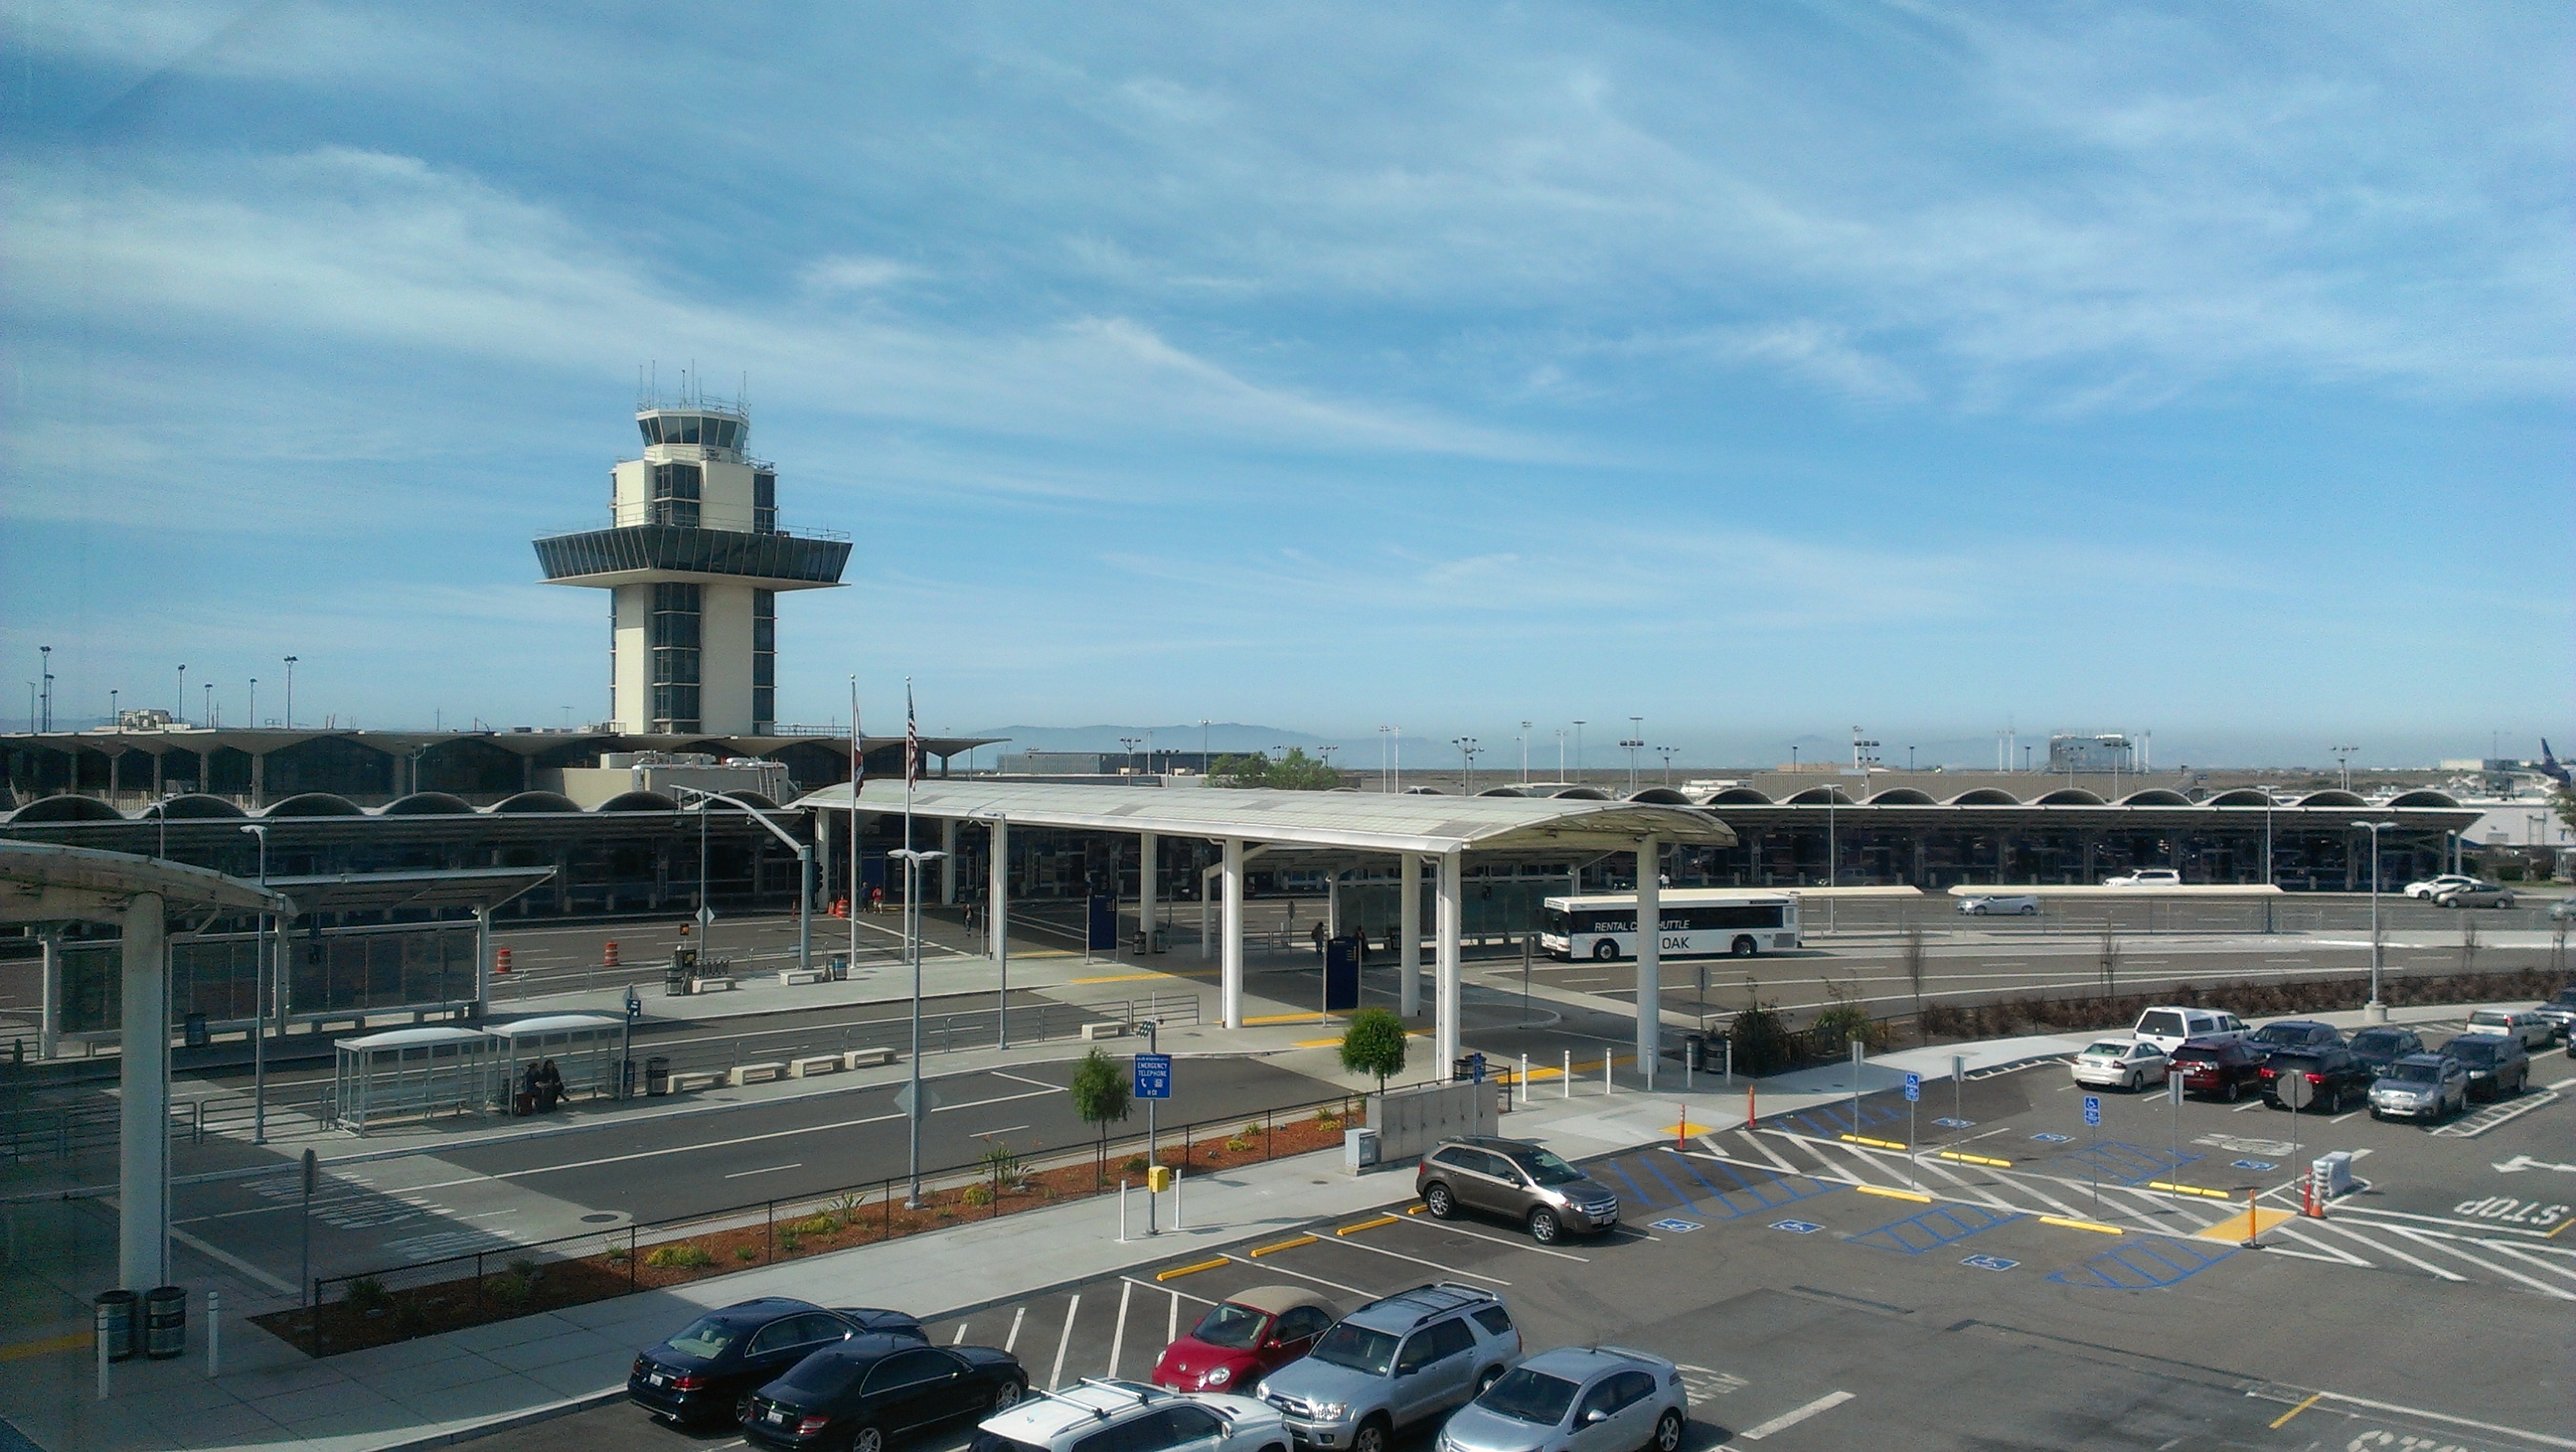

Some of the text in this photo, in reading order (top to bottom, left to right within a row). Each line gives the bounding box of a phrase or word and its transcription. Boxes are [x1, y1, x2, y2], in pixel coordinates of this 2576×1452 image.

[1594, 921, 1628, 932] RENTAL
[1658, 919, 1690, 930] HUTTLE
[1661, 937, 1690, 949] OAK
[2454, 1196, 2570, 1226] STOP
